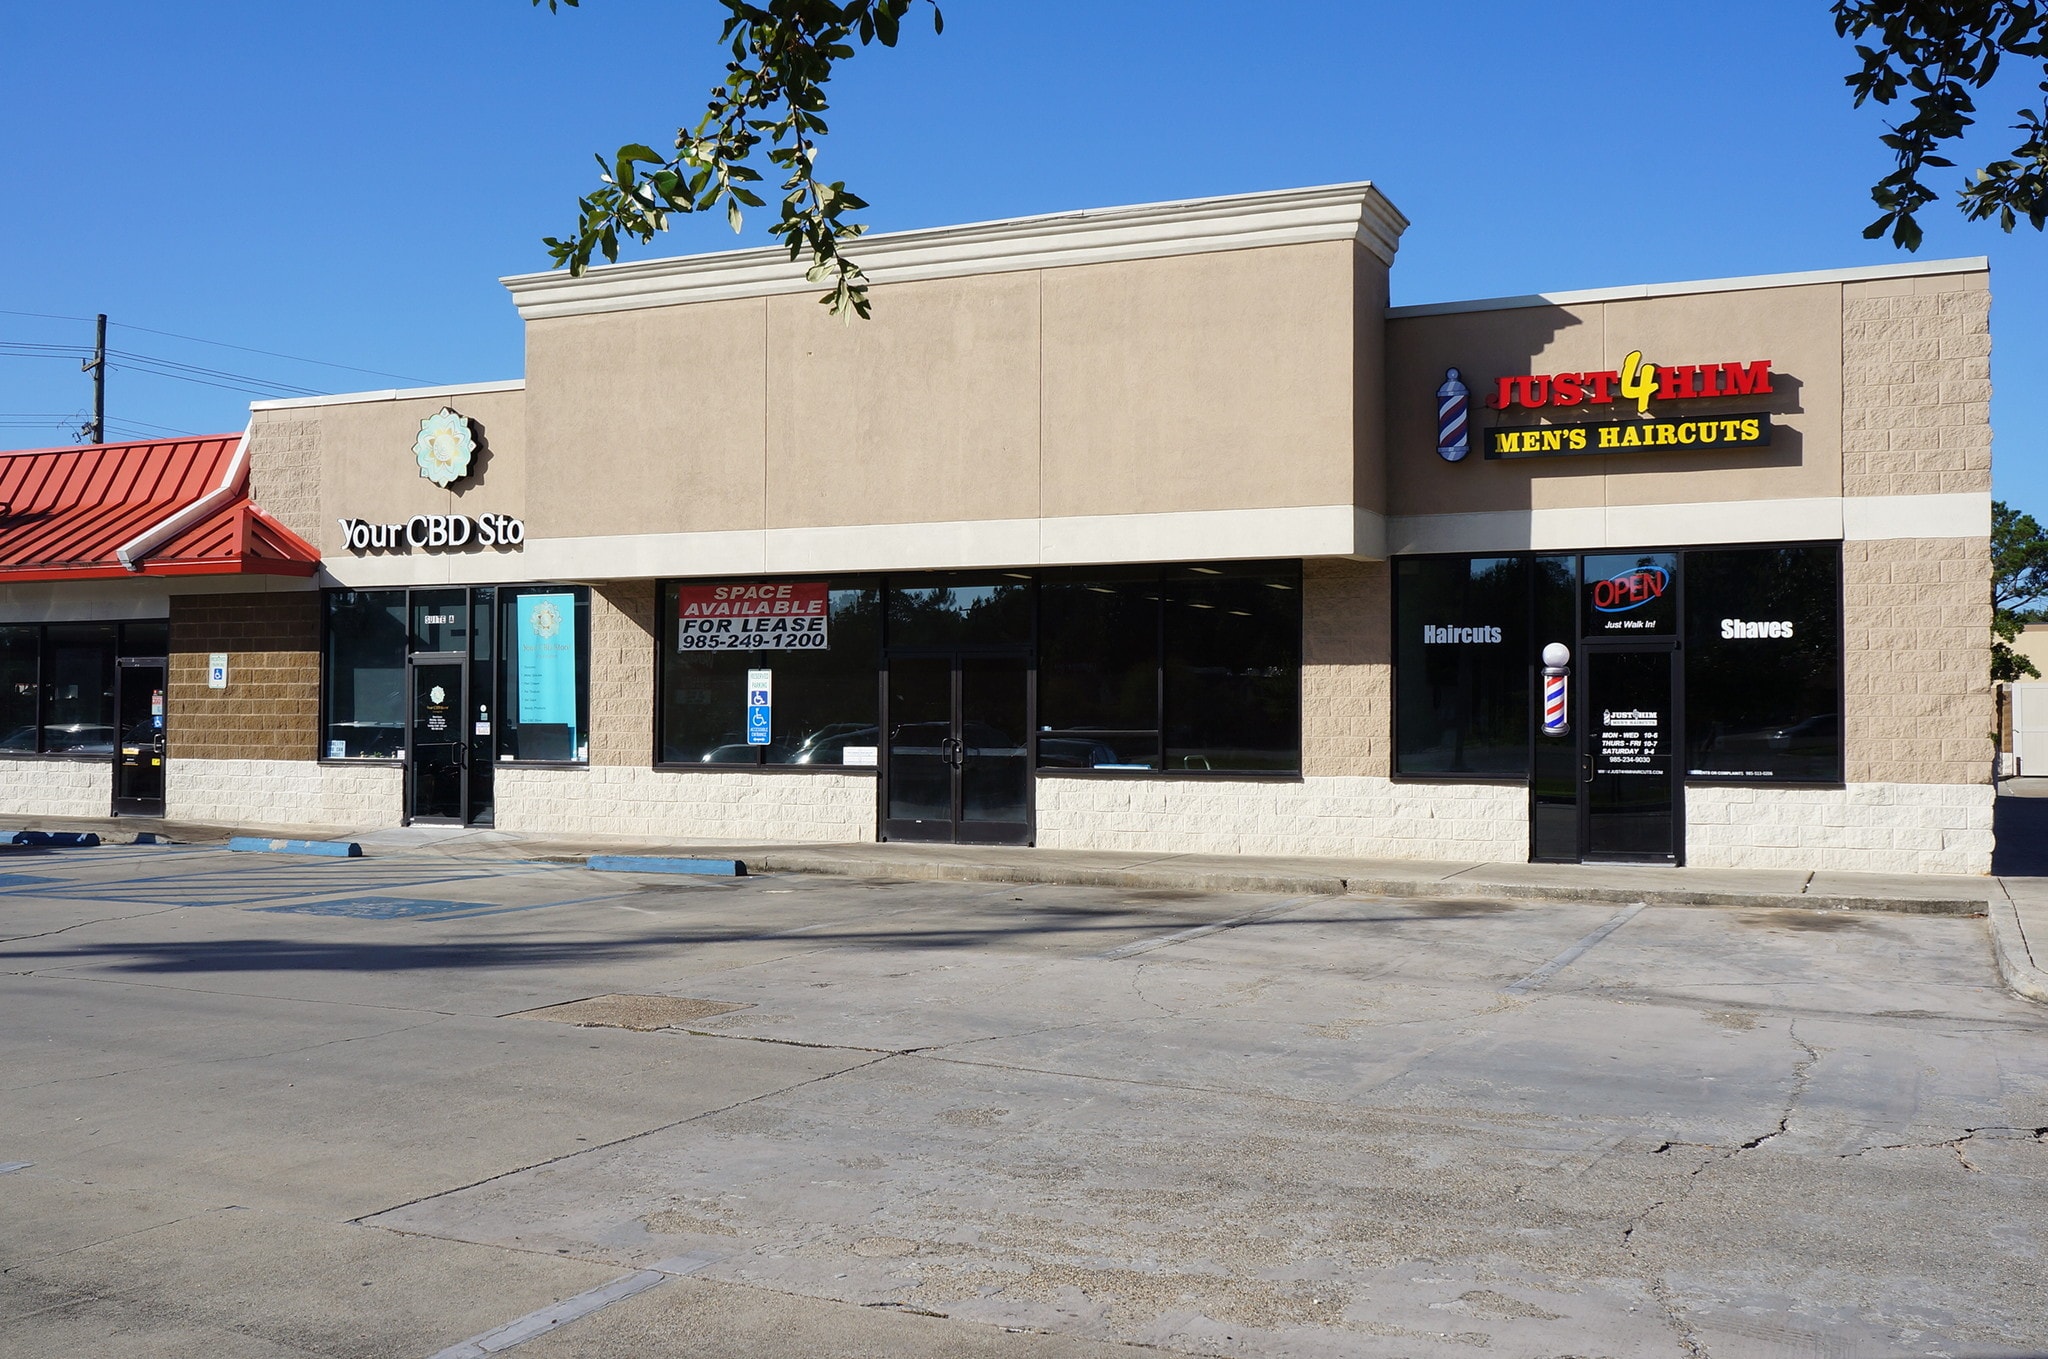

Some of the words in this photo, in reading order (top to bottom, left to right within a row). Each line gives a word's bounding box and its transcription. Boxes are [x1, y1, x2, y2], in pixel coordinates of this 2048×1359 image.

[1494, 428, 1587, 452] MEN'S
[1598, 419, 1760, 448] HAIRCUTS
[337, 518, 402, 550] Your
[406, 514, 471, 547] CBD
[477, 512, 525, 545] Sto
[714, 585, 793, 600] SPACE
[1593, 571, 1662, 608] OPEN
[684, 600, 823, 616] AVAILABLE
[424, 615, 447, 625] SUITE
[683, 619, 732, 634] FOR
[741, 617, 824, 633] LEASE
[1604, 620, 1623, 629] Just
[1623, 620, 1644, 629] Walk
[1644, 620, 1656, 629] In!
[1424, 624, 1502, 644] Haircuts
[1720, 618, 1794, 640] Shaves
[683, 633, 825, 649] 985-249-1200
